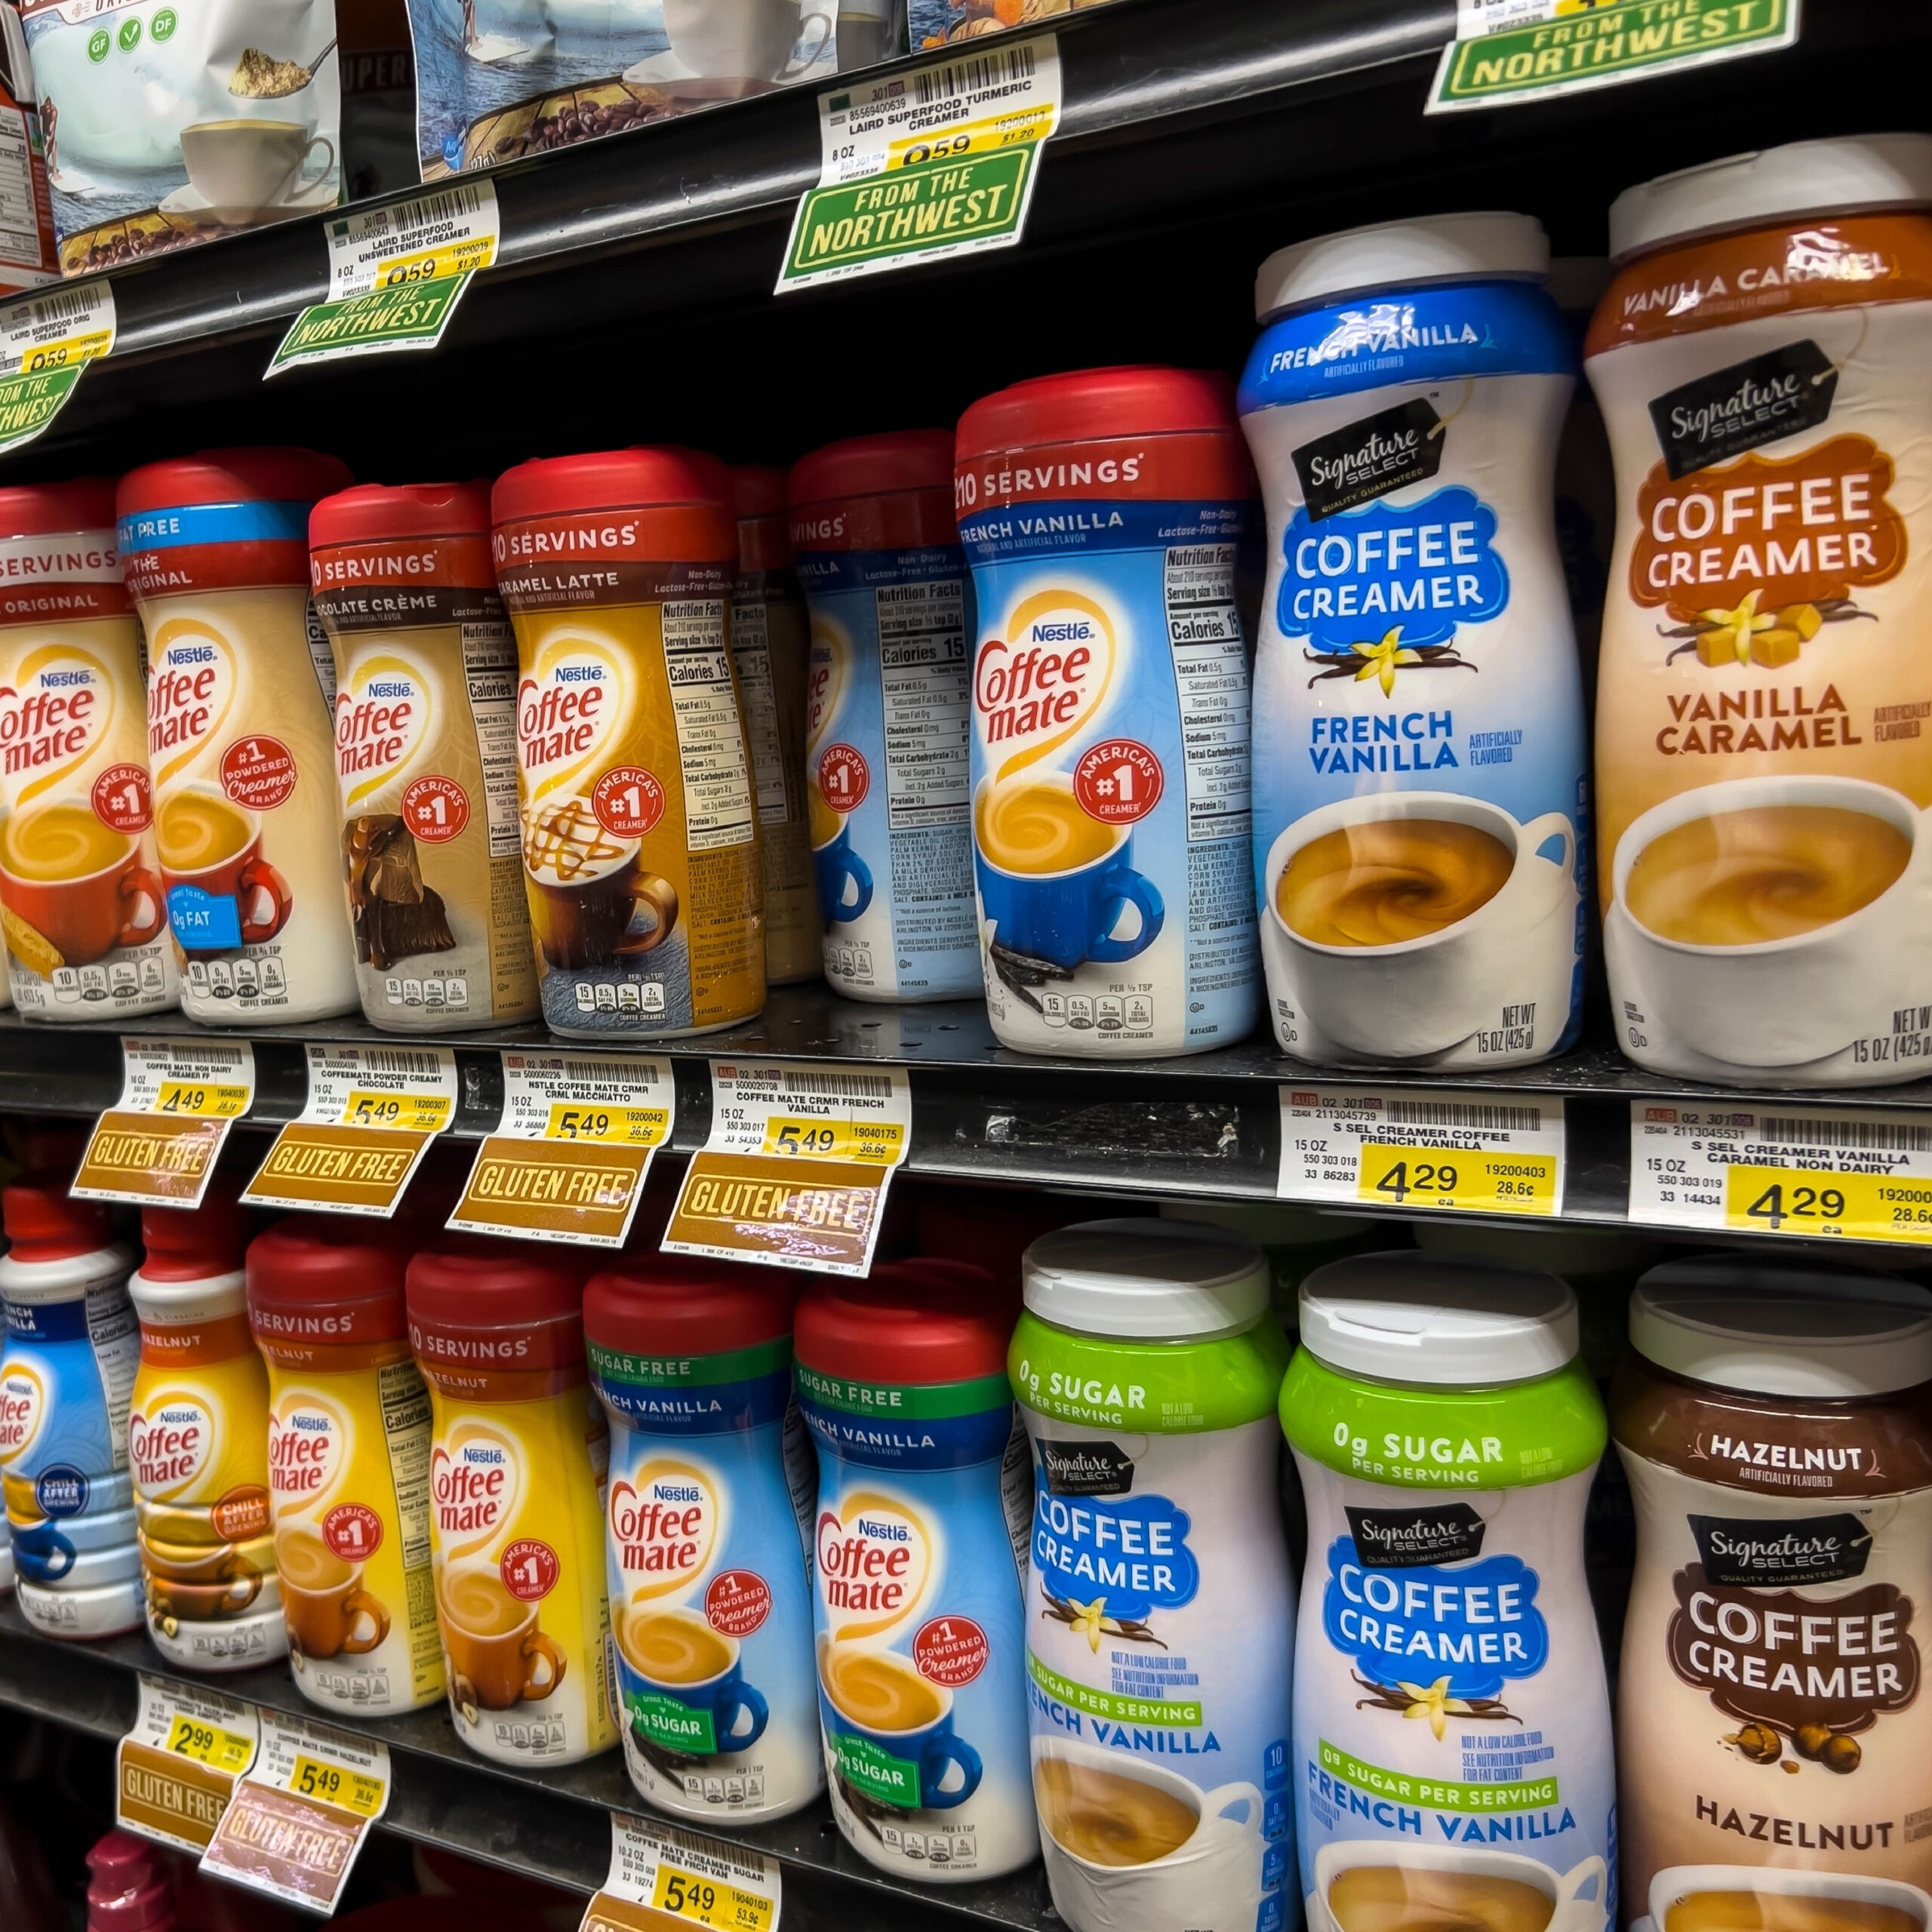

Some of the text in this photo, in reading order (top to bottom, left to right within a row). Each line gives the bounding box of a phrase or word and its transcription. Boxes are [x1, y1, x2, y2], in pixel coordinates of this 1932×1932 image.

[155, 18, 172, 32] DF
[91, 38, 106, 52] GF
[1472, 2, 1762, 85] NORTHWEST
[849, 80, 1032, 135] LAIRD SUPERFOOD TURMERIC
[849, 98, 906, 122] 85569400639
[908, 108, 970, 131] CREAMER
[854, 168, 974, 211] FROM THE
[808, 184, 1007, 257] NORTHWEST
[373, 221, 454, 250] LAIRD SUPERFOOD
[293, 297, 441, 348] NORTHWEST
[25, 377, 51, 398] THE
[1672, 373, 1801, 442] Signature
[1311, 426, 1419, 490] Signature
[1651, 473, 1872, 543] COFFEE
[137, 518, 180, 538] FREE
[961, 512, 1123, 544] FRENCH VANILLA
[1296, 521, 1481, 580] COFFEE
[1648, 532, 1878, 588] CREAMER
[133, 556, 159, 574] THE
[127, 571, 192, 592] ORIGINAL
[498, 572, 619, 596] CARAMEL LATTE
[5, 594, 99, 614] ORIGINAL
[1294, 574, 1484, 620] CREAMER
[881, 639, 965, 664] Calories 15
[669, 657, 729, 681] Calories 15
[976, 640, 1090, 713] Coffee
[469, 682, 512, 698] Calories
[1666, 683, 1847, 723] VANILLA
[986, 685, 1078, 743] mate
[1312, 710, 1452, 744] FRENCH
[5, 721, 87, 774] mate
[1469, 730, 1523, 749] ARTIFICIALLY
[1656, 715, 1862, 755] CARAMEL
[226, 757, 289, 781] POWDERED
[1081, 745, 1155, 779] AMERICA'S
[1309, 741, 1459, 774] VANILLA
[1470, 746, 1512, 766] FLAVORED
[226, 771, 297, 801] Creamer
[1097, 764, 1133, 801] #1
[1190, 801, 1217, 812] Protein
[174, 911, 210, 929] 0g FAT
[211, 1066, 232, 1074] DAIRY
[321, 1070, 443, 1083] COFFEEMATE POWDER CREAMY
[358, 1080, 405, 1089] CHOCOLATE
[528, 1081, 649, 1094] NSTLE COFFEE MATE CRMR
[545, 1091, 631, 1102] CRML MACCHIATTO
[736, 1092, 884, 1108] COFFEE MATE CRMR FRENCH
[787, 1104, 830, 1115] VANILLA
[1315, 1109, 1377, 1121] 2113045739
[854, 1128, 897, 1139] 19040175
[1294, 1140, 1327, 1152] 15 OZ
[1333, 1122, 1510, 1143] S SEL CREAMER COFFEE
[1360, 1135, 1481, 1151] FRENCH VANILLA
[1673, 1125, 1746, 1140] 2113045531
[94, 1136, 208, 1171] GLUTEN FREE
[273, 1146, 407, 1180] GLUTEN FREE
[1646, 1158, 1687, 1173] 15 OZ
[1690, 1140, 1909, 1164] S SEL CREAMER VANILLA
[1706, 1153, 1895, 1175] CARAMEL NON DAIRY
[1485, 1164, 1546, 1178] 19200403
[591, 1347, 691, 1375] SUGAR FREE
[799, 1369, 903, 1407] SUGAR FREE
[636, 1399, 722, 1414] VANILLA
[1030, 1392, 1122, 1424] PER SERVING
[842, 1427, 935, 1448] VANILLA
[1333, 1422, 1367, 1457] 0g
[1383, 1433, 1503, 1463] SUGAR
[1045, 1451, 1111, 1480] Signature
[1709, 1434, 1862, 1471] HAZELNUT
[139, 1454, 194, 1484] mate
[272, 1466, 322, 1491] mate
[1352, 1457, 1479, 1484] PER SERVING
[1739, 1467, 1832, 1487] ARTIFICIALLY FLAVORED
[223, 1498, 263, 1516] CHILL
[611, 1481, 702, 1542] Coffee
[1038, 1491, 1174, 1556] COFFEE
[1361, 1518, 1461, 1550] Signature
[1394, 1535, 1460, 1552] SELECT
[1710, 1531, 1841, 1567] Signature
[1037, 1531, 1176, 1592] CREAMER
[1752, 1551, 1839, 1568] SELECT
[1720, 1568, 1844, 1583] QUALITY GUARANTEED
[1339, 1564, 1522, 1625] COFFEE
[1340, 1609, 1527, 1664] CREAMER
[1688, 1591, 1900, 1657] COFFEE
[919, 1636, 981, 1658] POWDERED
[1688, 1640, 1903, 1699] CREAMER
[1091, 1718, 1221, 1753] VANILLA
[1463, 1746, 1555, 1766] SEE NUTRITION INFORMATION
[1324, 1748, 1552, 1806] 0g SUGAR PER SERVING
[1463, 1766, 1523, 1781] FOR FAT CONTENT
[127, 1770, 226, 1823] GLUTEN FREE
[1308, 1759, 1422, 1835] FRENCH
[1436, 1807, 1577, 1843] VANILLA
[1696, 1794, 1894, 1850] HAZELNUT
[626, 1833, 764, 1883] COFFEE MATE CREAMER SUGAR
[660, 1851, 728, 1879] FREE FRCH VAN
